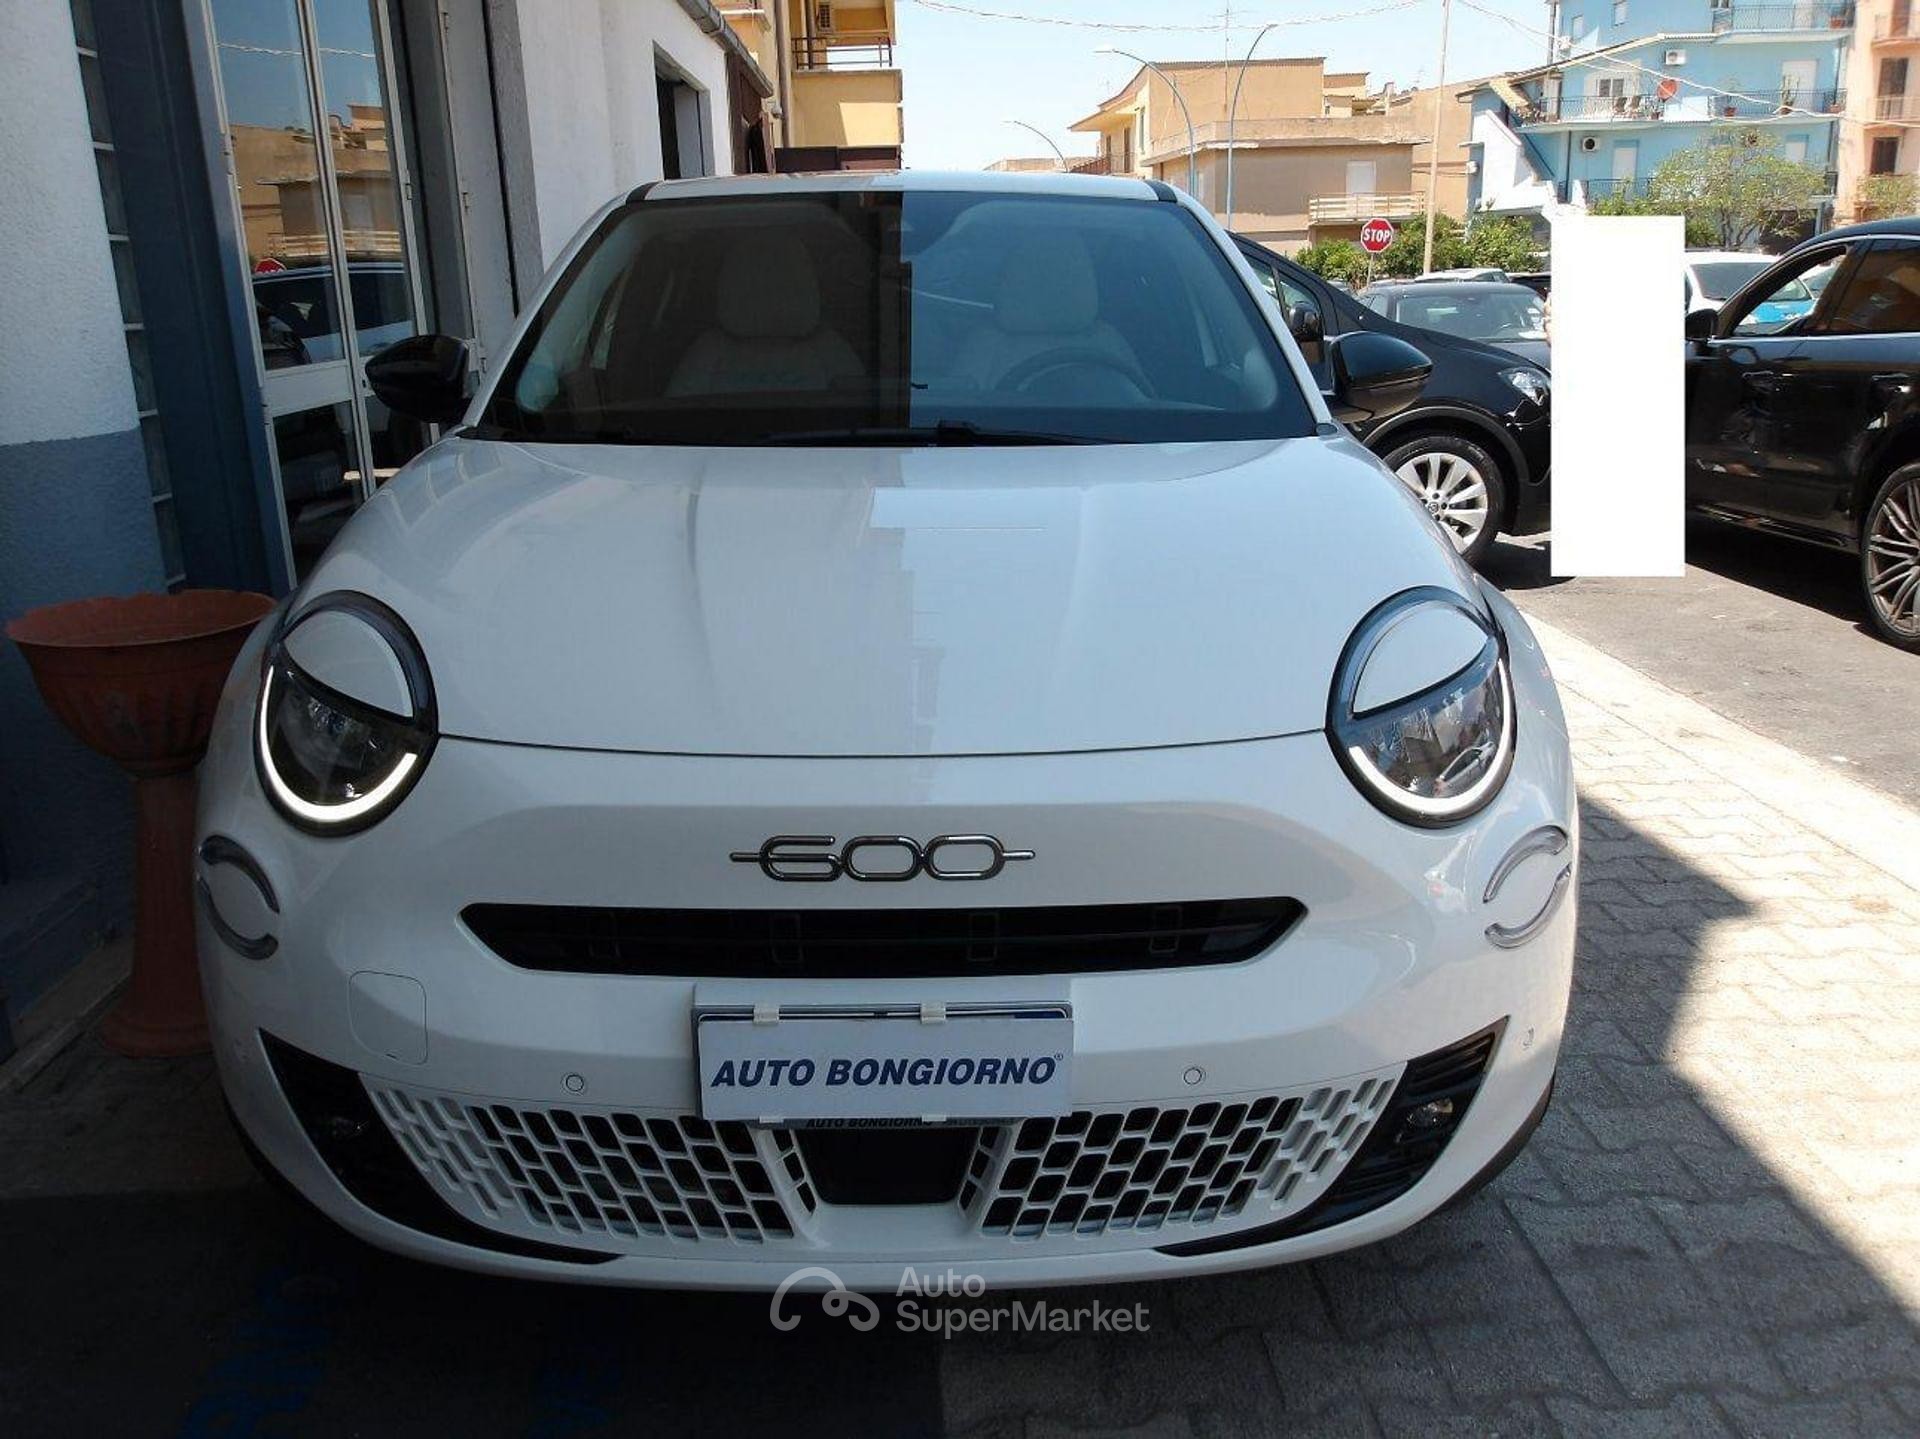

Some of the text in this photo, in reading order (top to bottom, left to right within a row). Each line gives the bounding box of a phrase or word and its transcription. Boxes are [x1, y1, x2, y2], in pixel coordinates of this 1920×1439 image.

[1363, 228, 1390, 243] STOP
[759, 834, 1006, 882] 600
[711, 1059, 815, 1087] AUTO
[806, 1117, 844, 1128] AUTO
